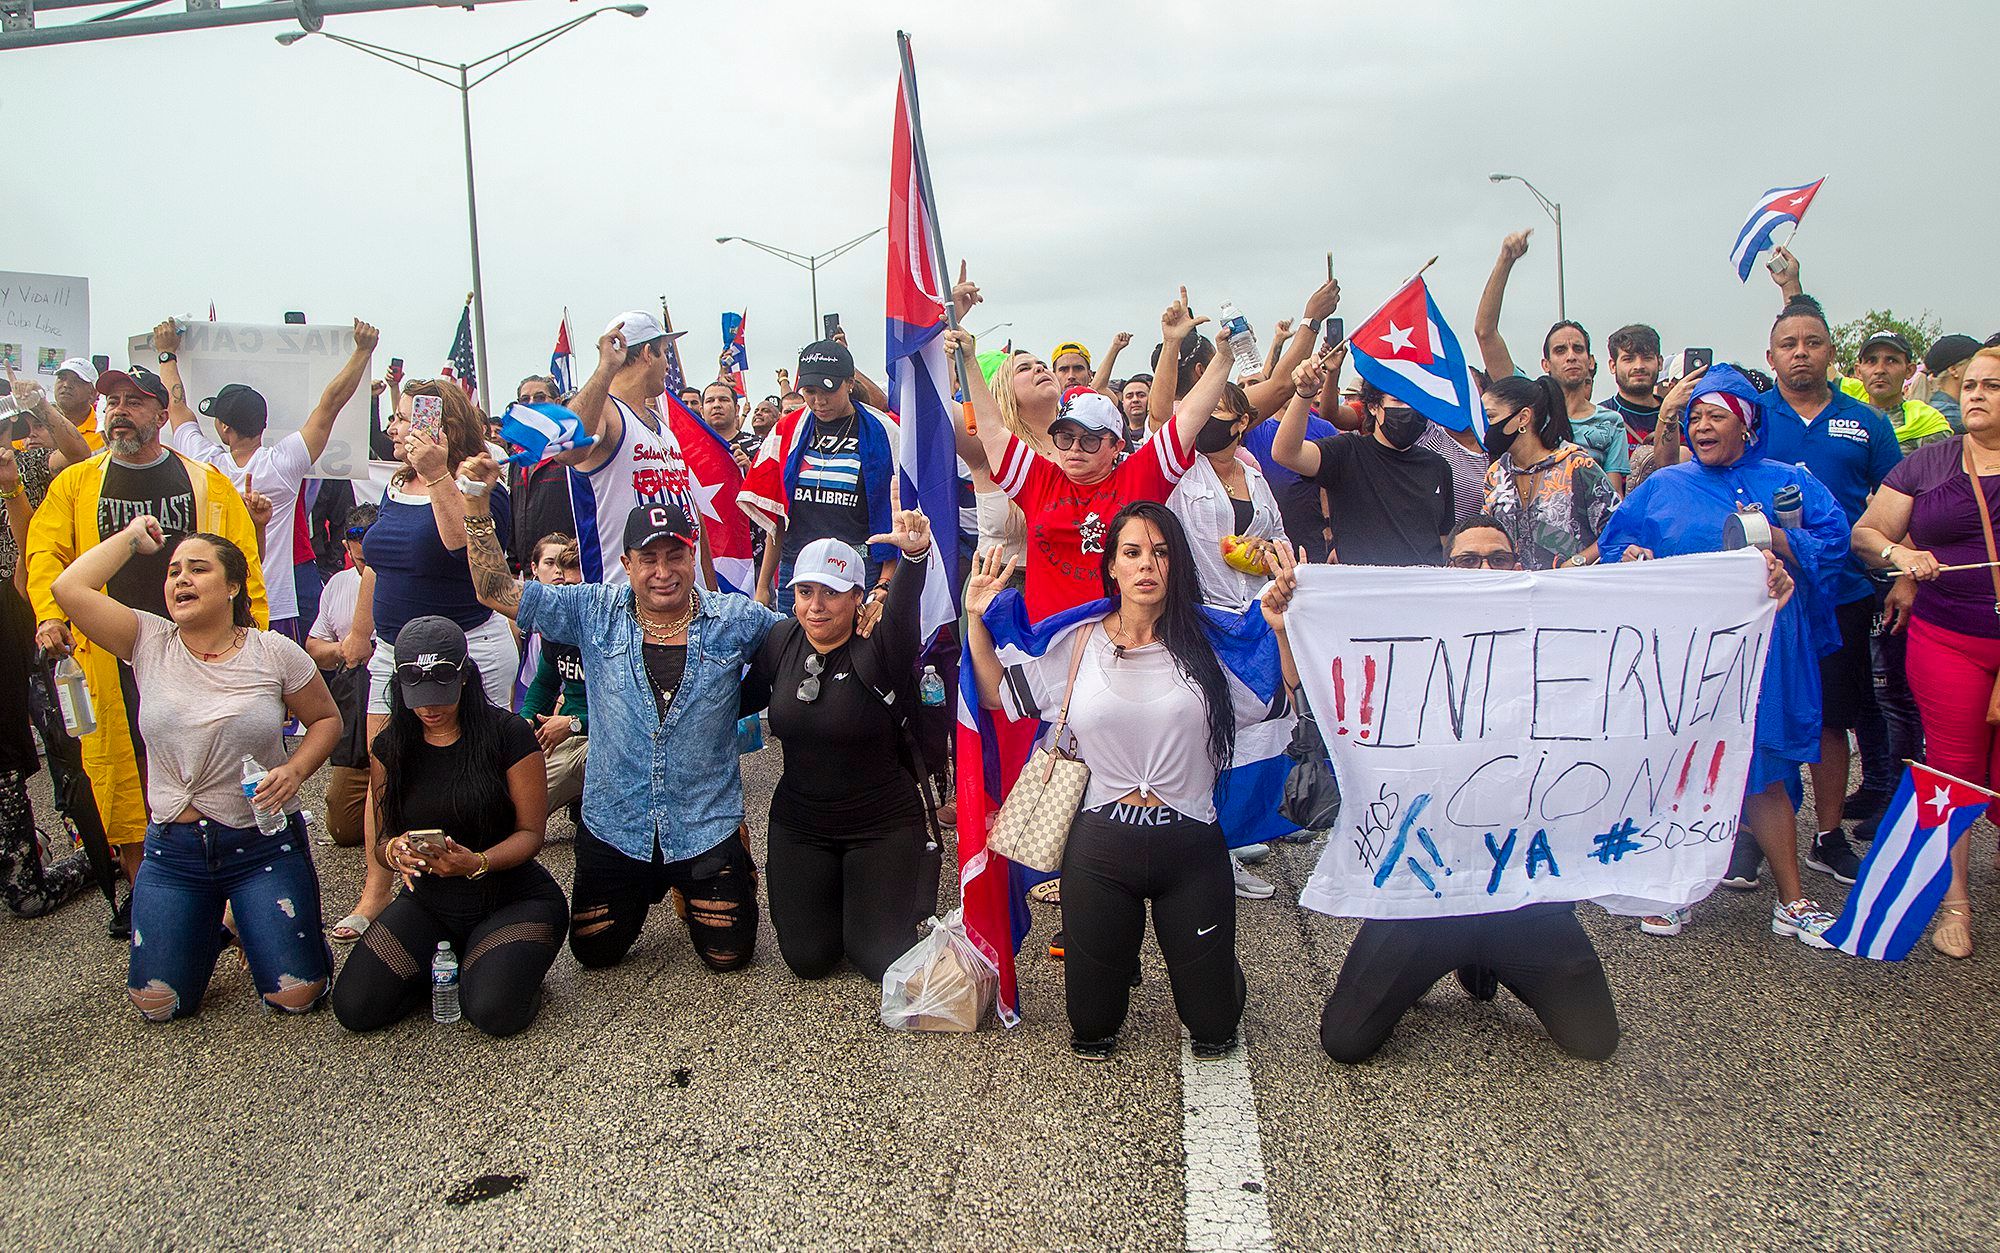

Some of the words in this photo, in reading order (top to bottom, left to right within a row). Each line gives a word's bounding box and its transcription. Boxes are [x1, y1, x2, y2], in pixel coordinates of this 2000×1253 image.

[815, 490, 859, 507] LIBRE!!
[650, 507, 668, 527] C
[417, 653, 438, 666] NIKE
[1110, 803, 1170, 826] NIKE
[1587, 815, 1739, 865] #SOSCU
[1484, 828, 1561, 895] YA
